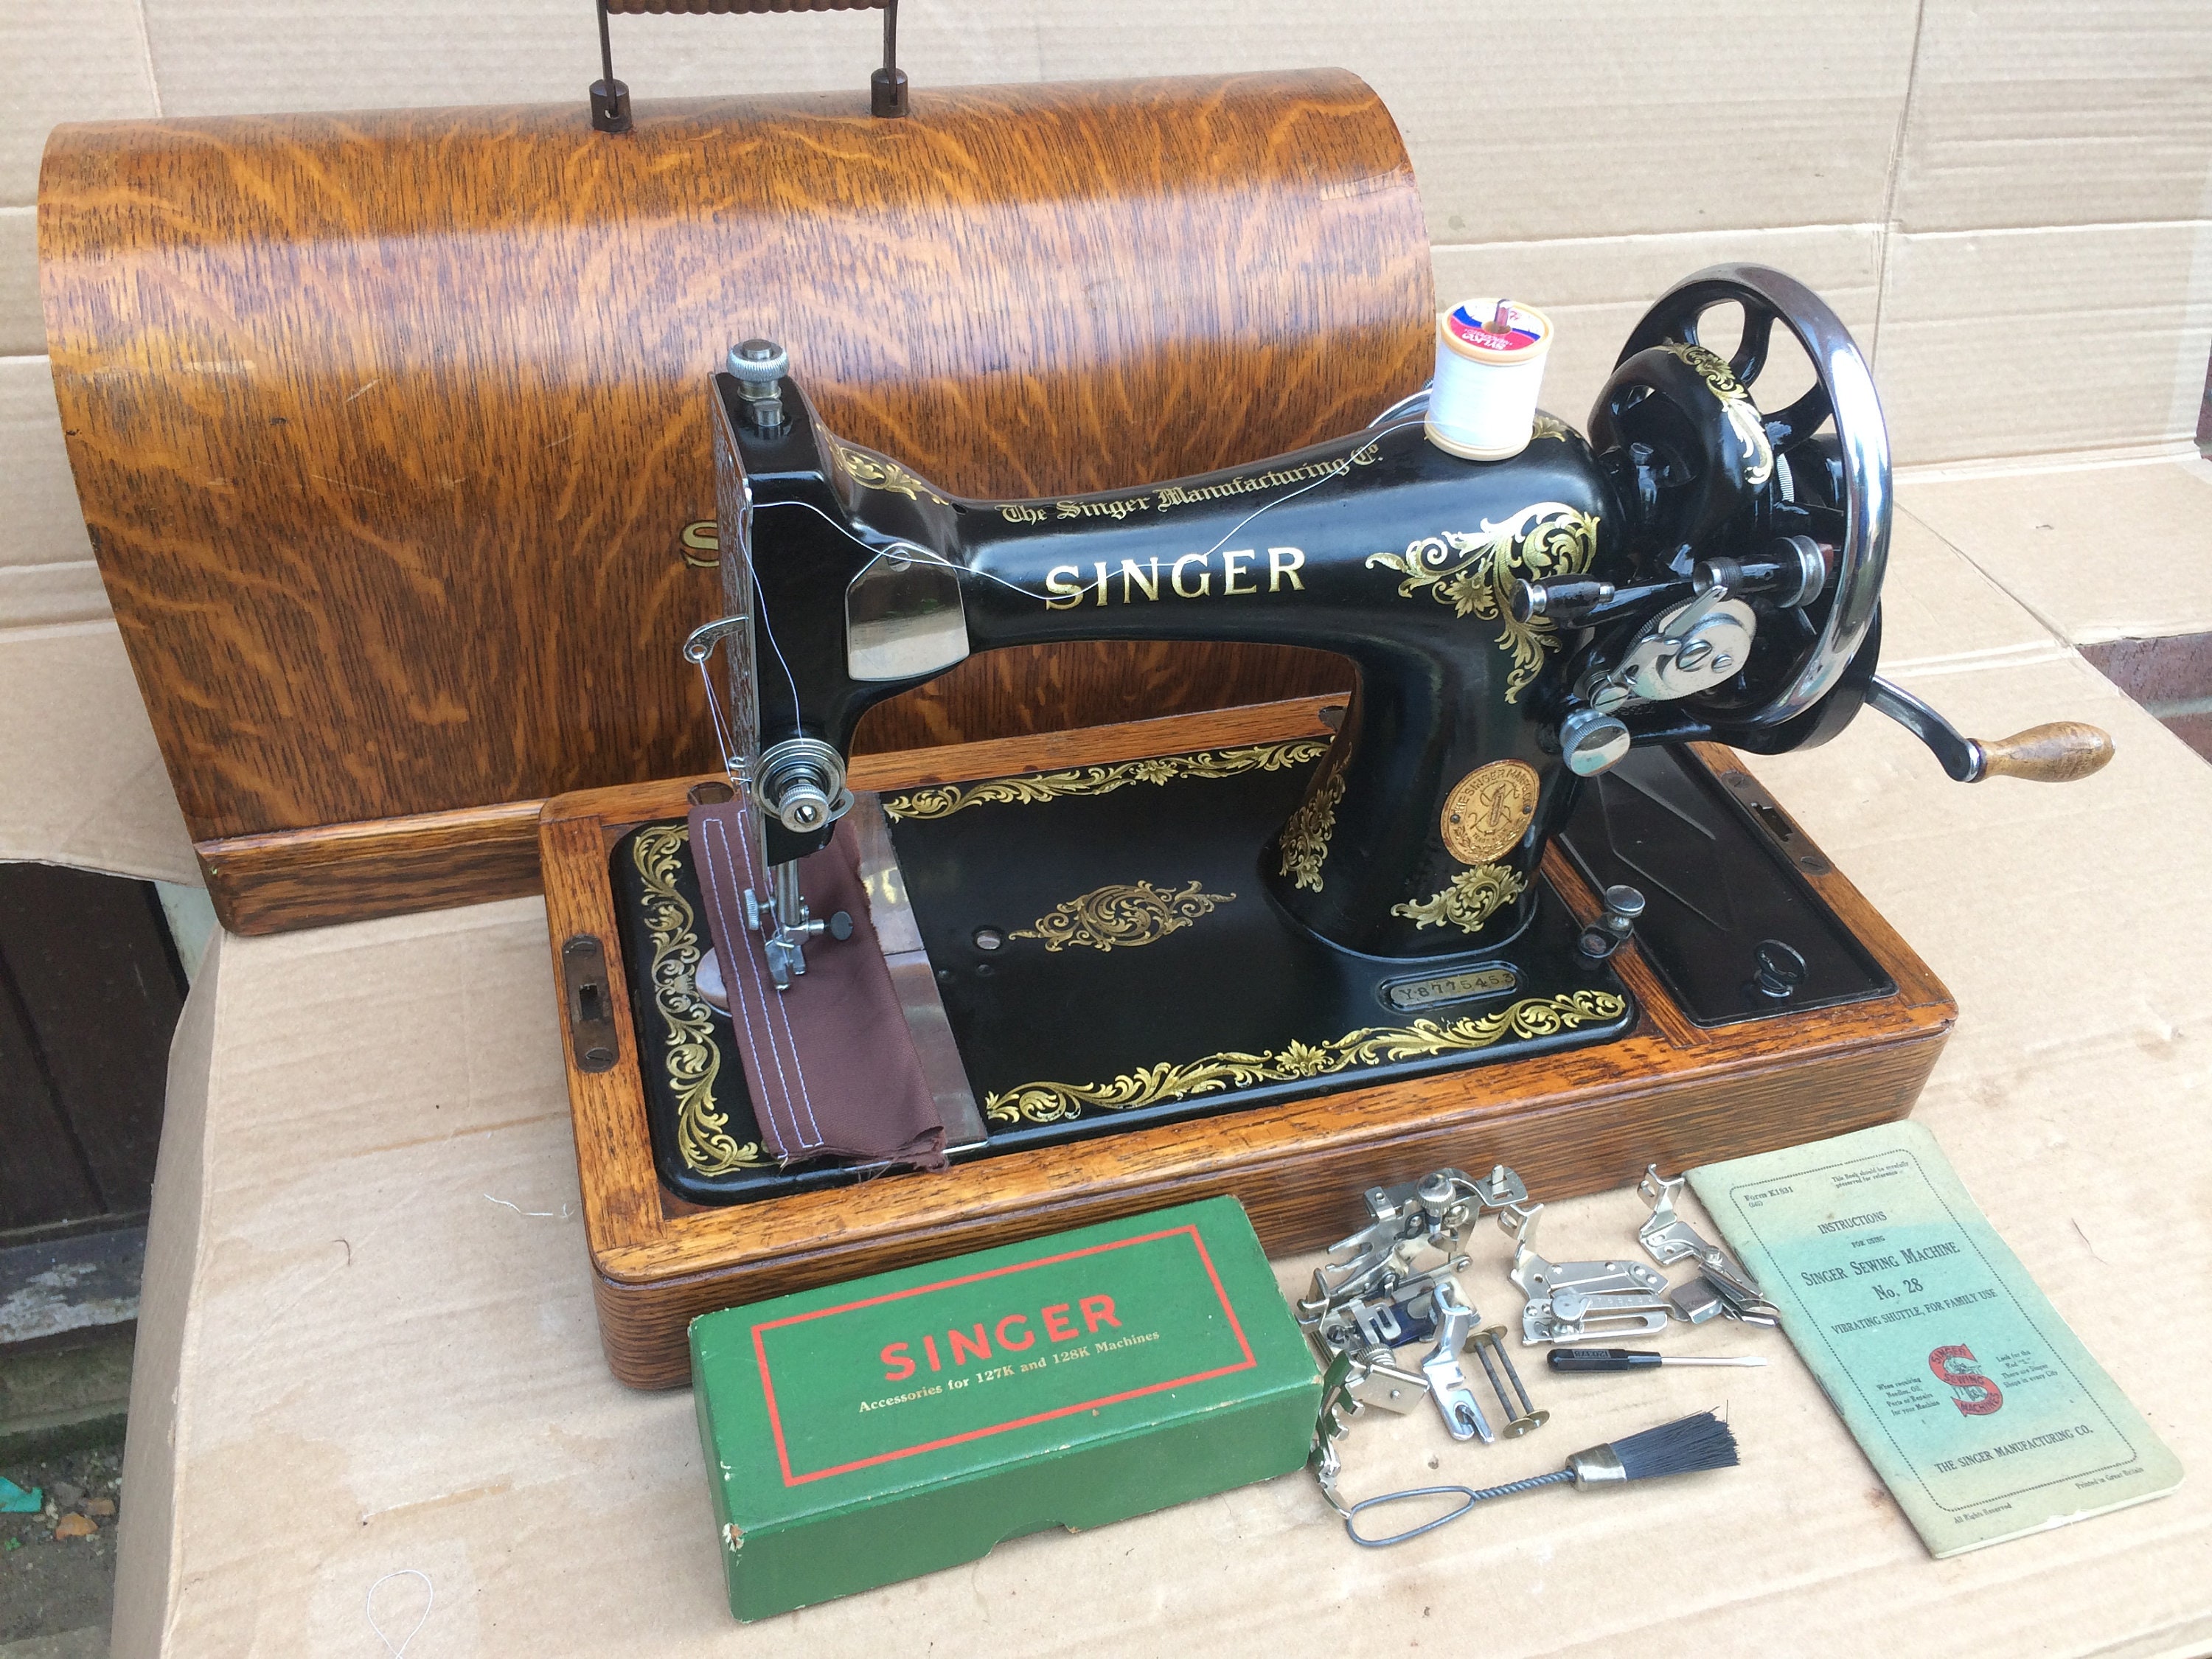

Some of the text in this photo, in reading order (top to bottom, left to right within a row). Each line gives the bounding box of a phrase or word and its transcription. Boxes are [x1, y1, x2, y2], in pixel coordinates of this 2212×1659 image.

[995, 504, 1048, 524] The
[1056, 496, 1150, 520] Singer
[1152, 454, 1351, 512] Manufacturing
[1045, 546, 1306, 611] SINGER
[1744, 1193, 1767, 1201] Form
[1818, 1211, 1887, 1234] INSTRUCTIONS
[1851, 1236, 1885, 1248] FOR USING
[1801, 1242, 1961, 1286] SINGER SEWING MACHINE
[1902, 1278, 1924, 1293] 28
[1831, 1288, 1998, 1335] VIBRATING SHUTTLE, FOR FAMILY USE
[880, 1293, 1122, 1381] SINGER
[1932, 1348, 1966, 1363] SINGER
[858, 1331, 1160, 1413] Accessories for 127K and 128K Machines
[1944, 1374, 1984, 1385] SEWING
[1934, 1425, 2093, 1473] THE SINGER MANUFACTURING CO.
